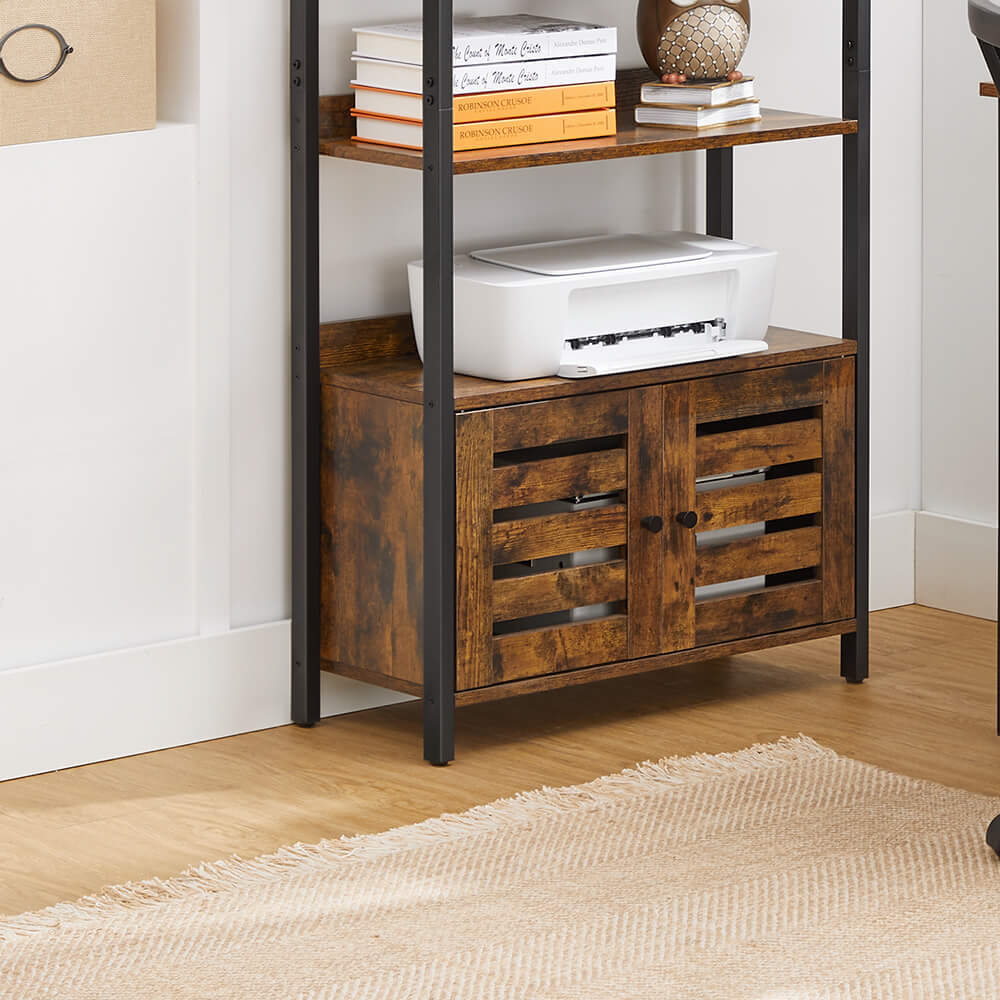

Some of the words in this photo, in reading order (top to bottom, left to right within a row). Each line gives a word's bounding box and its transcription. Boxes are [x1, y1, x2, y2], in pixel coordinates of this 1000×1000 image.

[463, 44, 483, 62] Count
[495, 43, 518, 57] Monte
[521, 40, 542, 57] Cristo
[461, 72, 480, 89] Count
[492, 71, 515, 85] Monte
[517, 68, 539, 85] Cristo
[458, 99, 501, 112] ROBINSON
[500, 96, 533, 107] CRUSOE
[459, 127, 501, 139] ROBINSON
[501, 124, 533, 135] CRUSOE
